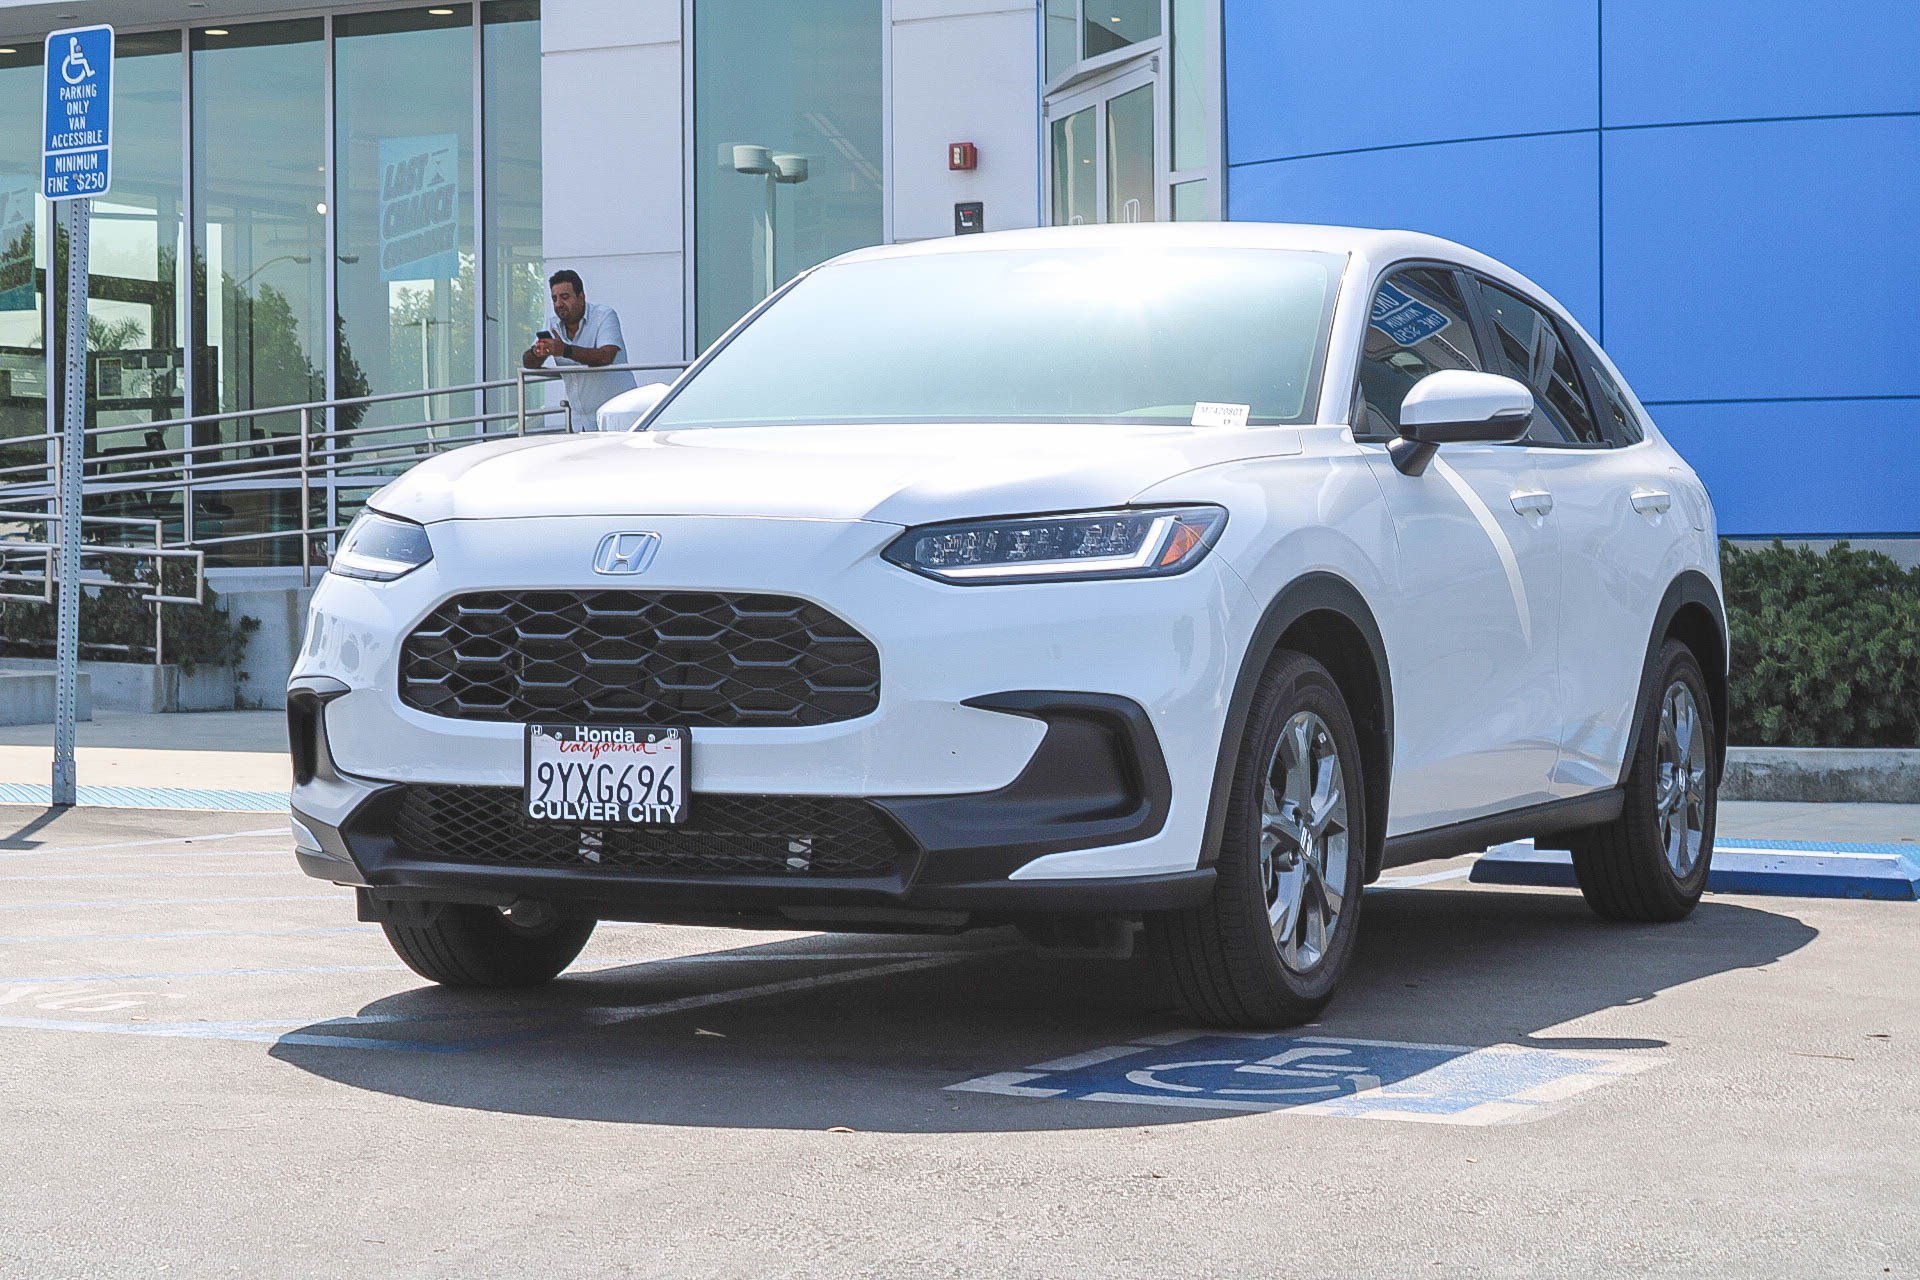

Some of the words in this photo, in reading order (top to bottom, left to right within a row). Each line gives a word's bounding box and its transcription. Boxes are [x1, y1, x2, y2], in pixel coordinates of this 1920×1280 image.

[60, 84, 97, 101] PARKING
[67, 101, 89, 115] ONLY
[69, 117, 86, 130] VAN
[51, 130, 103, 148] ACCESSIBLE
[55, 152, 98, 173] MINIMUM
[48, 176, 70, 193] FINE
[77, 172, 105, 191] $250
[575, 725, 635, 743] Honda
[559, 739, 657, 760] California
[537, 762, 676, 806] 9YXG696
[528, 800, 620, 822] CULVER
[627, 803, 680, 823] CITY
